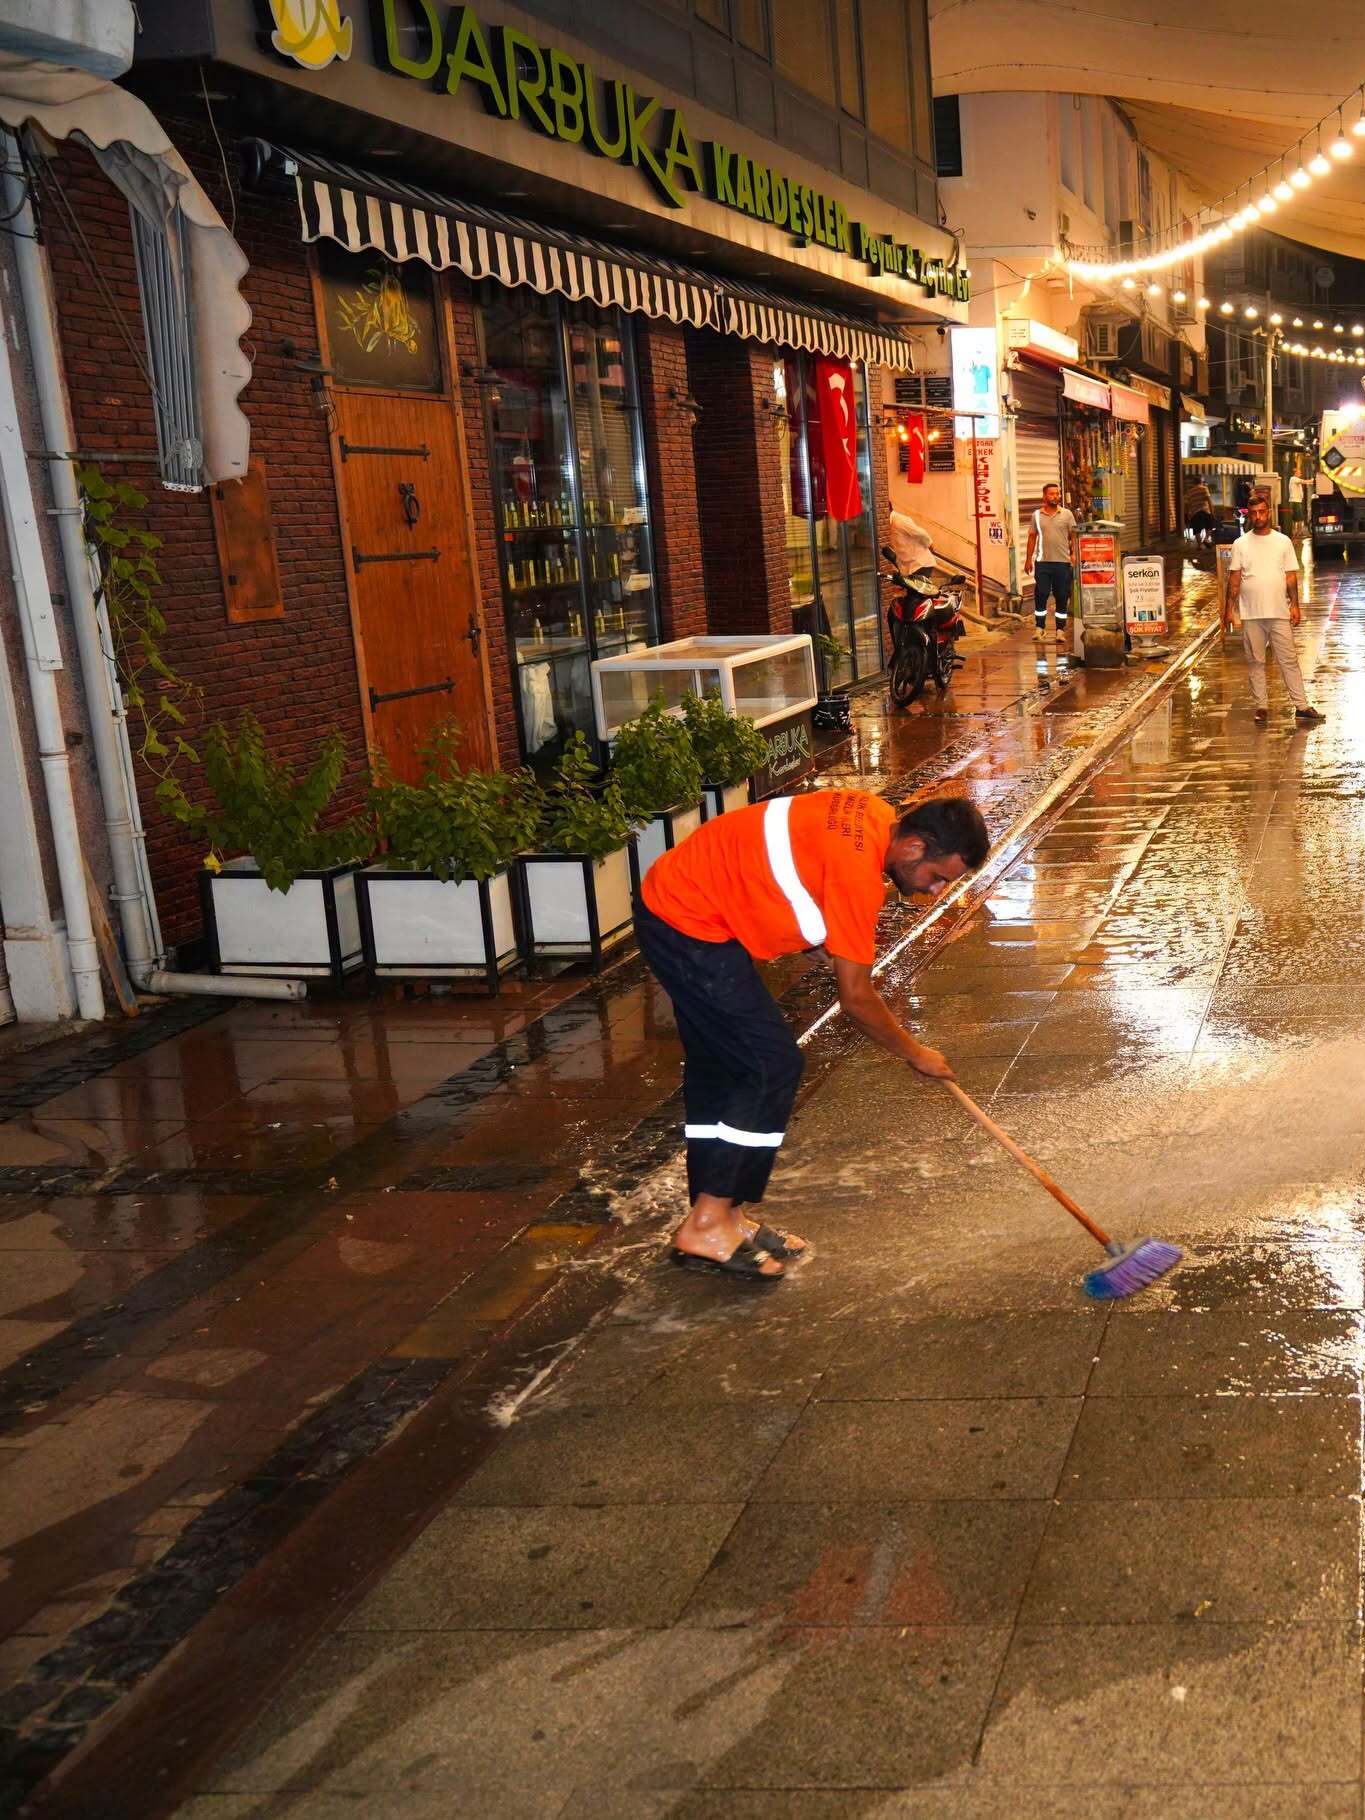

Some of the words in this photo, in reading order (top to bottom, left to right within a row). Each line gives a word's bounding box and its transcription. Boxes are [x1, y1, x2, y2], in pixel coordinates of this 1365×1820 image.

[383, 0, 704, 208] DARBUKA
[712, 142, 852, 254] KARDEŞLER
[860, 223, 903, 277] Peynir
[905, 245, 917, 281] &
[968, 448, 994, 456] EKEK
[1127, 568, 1160, 579] serkan
[761, 723, 811, 768] ARBUKA
